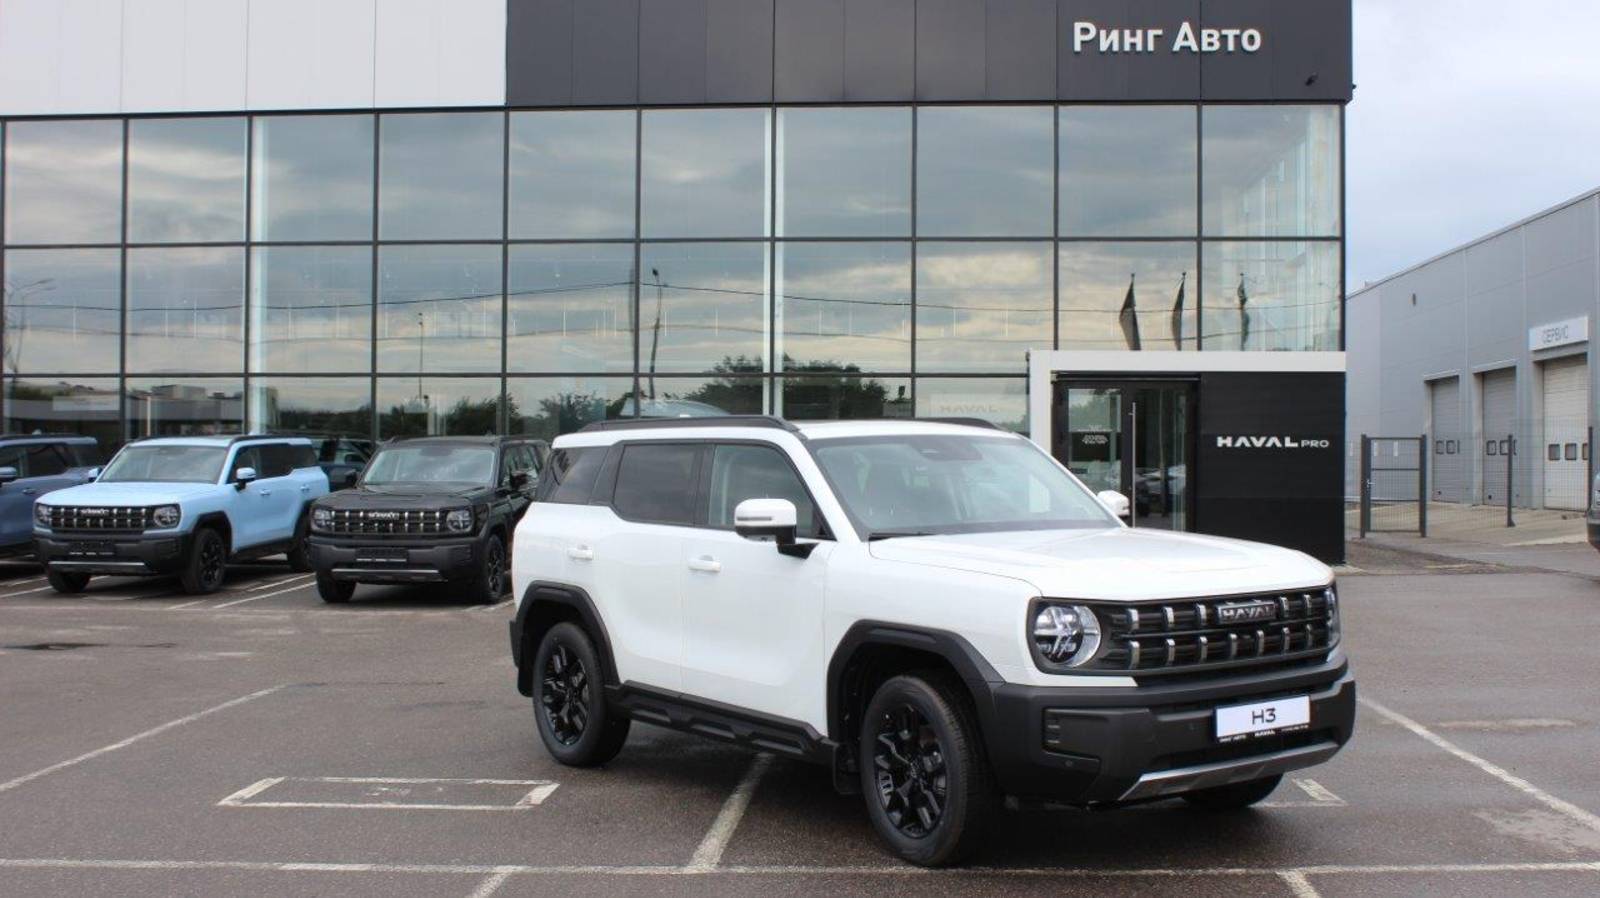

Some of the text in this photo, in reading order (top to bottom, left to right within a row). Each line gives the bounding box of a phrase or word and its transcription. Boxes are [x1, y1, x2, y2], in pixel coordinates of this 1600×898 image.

[1073, 21, 1263, 52] Ринг Авто
[1216, 436, 1330, 449] HAVAL PRO
[1251, 707, 1277, 725] H3
